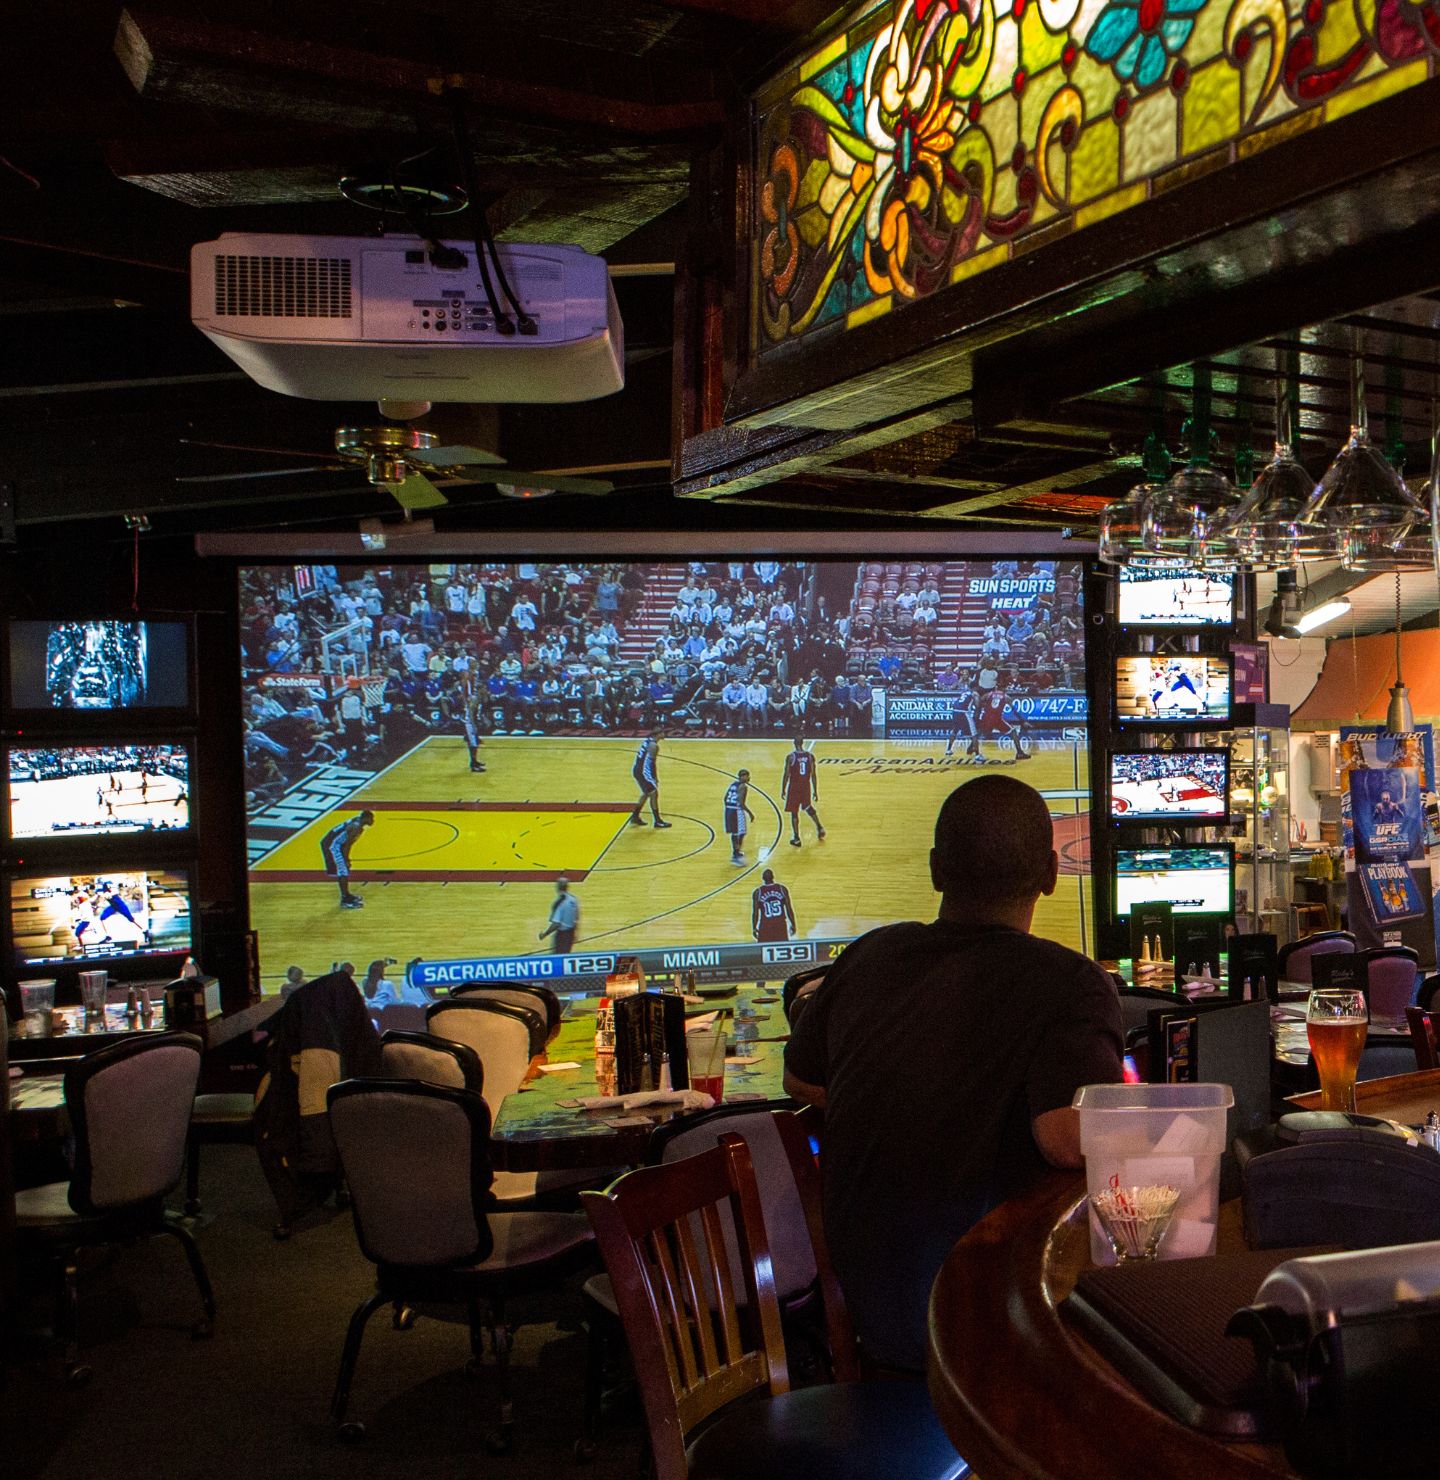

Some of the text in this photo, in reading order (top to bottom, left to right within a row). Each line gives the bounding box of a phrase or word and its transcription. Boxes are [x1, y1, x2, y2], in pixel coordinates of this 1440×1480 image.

[969, 579, 1056, 594] SUN SPORTS
[991, 594, 1037, 609] HEAT
[889, 701, 935, 711] ANIDJAR
[1346, 731, 1427, 741] BUD LIGHT
[818, 757, 1016, 765] mericanAirlines
[250, 764, 377, 829] HEAT
[1376, 825, 1399, 835] UFC
[1367, 866, 1409, 880] PLAYBOOK
[763, 900, 782, 918] 15
[424, 960, 554, 982] SACRAMENTO
[567, 957, 614, 974] 129
[663, 951, 721, 969] MIAMI
[765, 946, 810, 962] 139
